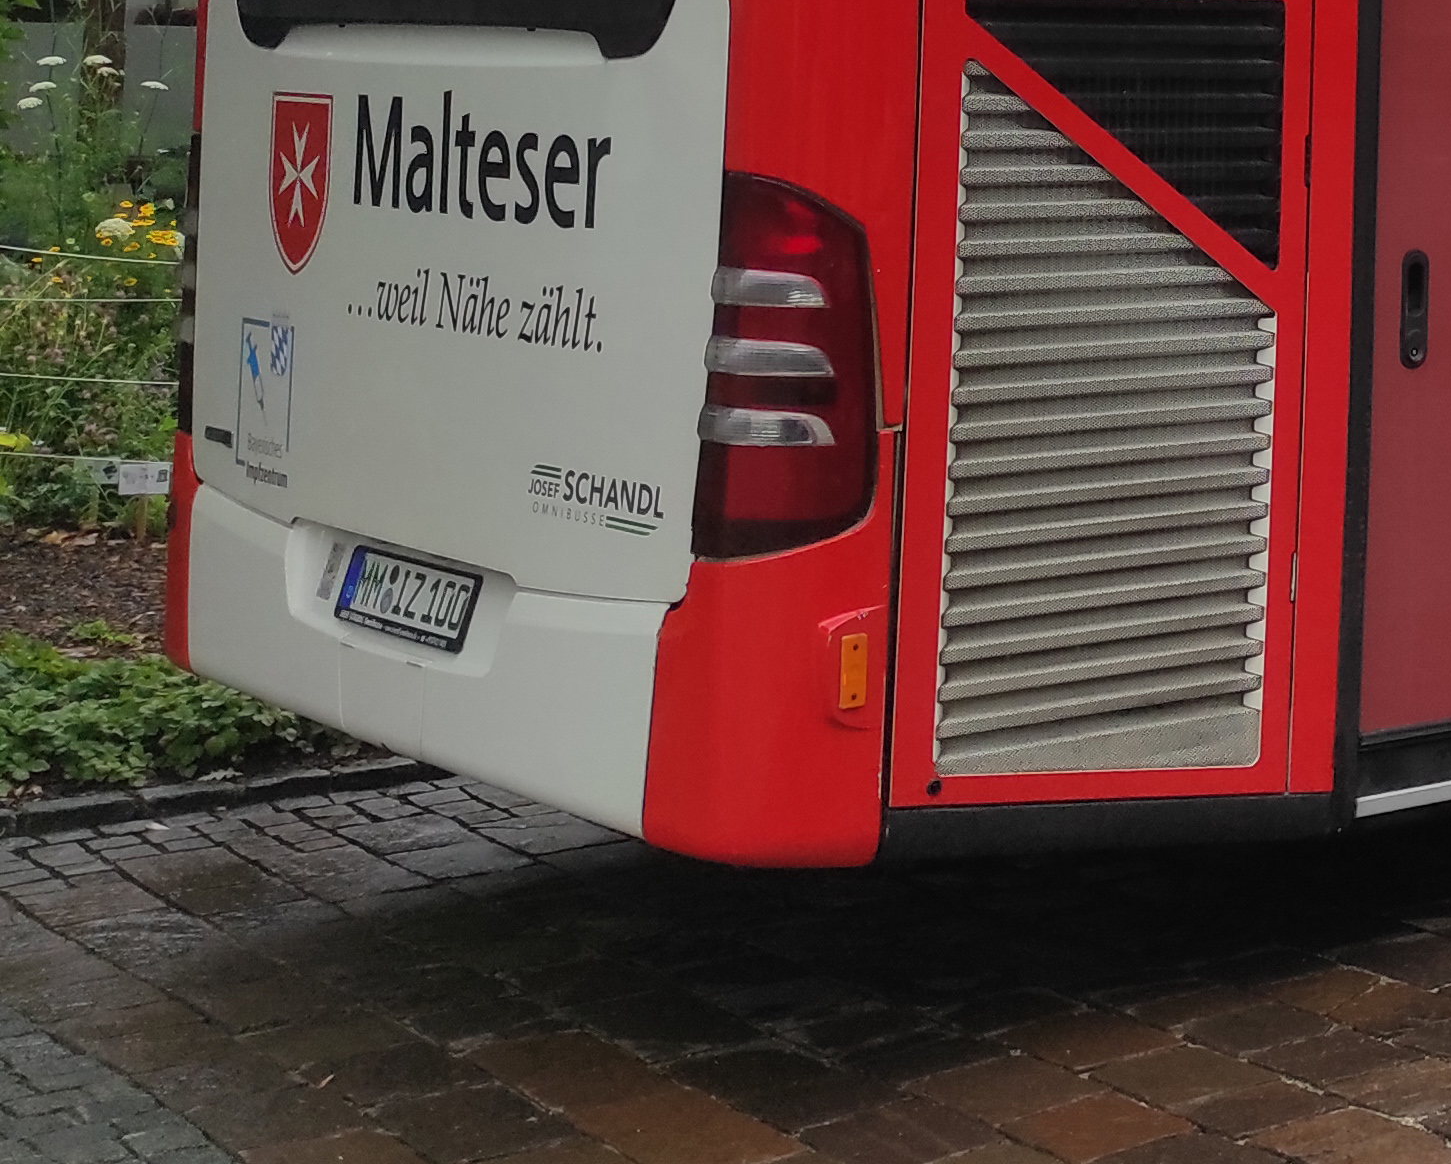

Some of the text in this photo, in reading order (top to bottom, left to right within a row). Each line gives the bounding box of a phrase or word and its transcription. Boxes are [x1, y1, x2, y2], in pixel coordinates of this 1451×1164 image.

[353, 89, 612, 229] Malteser
[347, 268, 603, 354] ...weil Nähe zählt.
[528, 469, 665, 520] JOSEF SCHANDL
[532, 501, 605, 527] OMNIBUSSE
